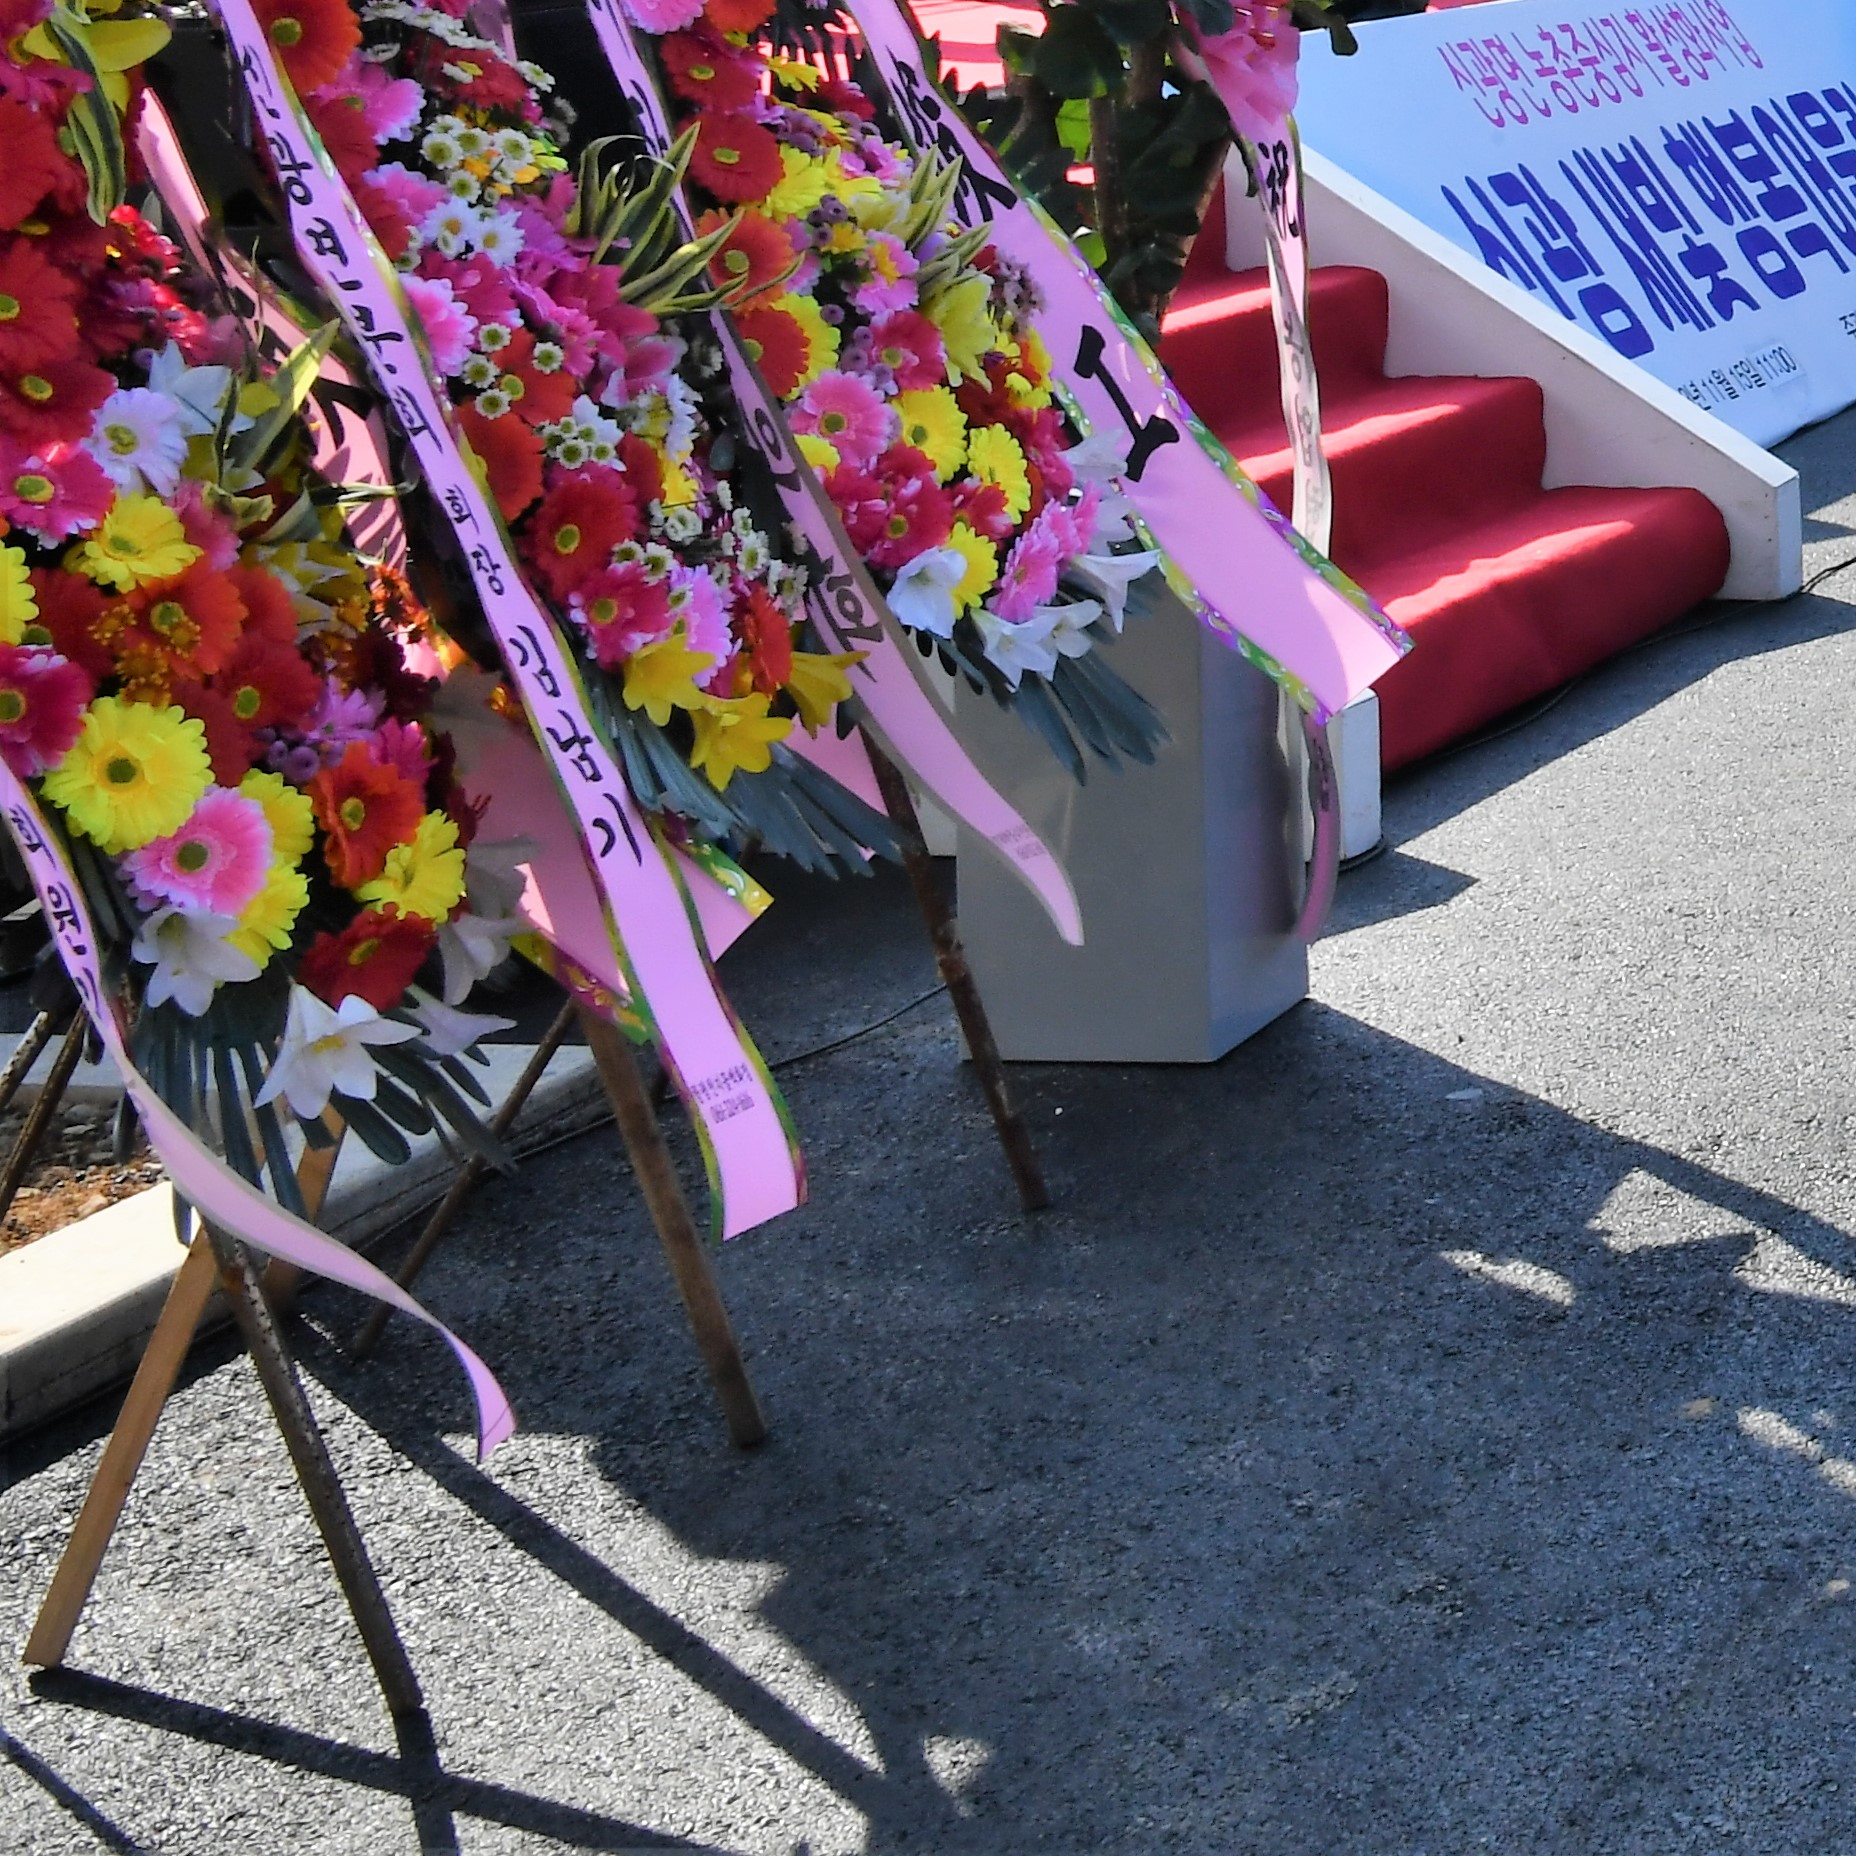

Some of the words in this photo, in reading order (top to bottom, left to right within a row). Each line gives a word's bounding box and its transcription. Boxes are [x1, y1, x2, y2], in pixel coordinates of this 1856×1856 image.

[1437, 33, 1551, 129] 신광면
[1511, 12, 1664, 114] 농촌중심지
[1441, 162, 1655, 359] 신광
[1558, 134, 1761, 333] 새빛
[510, 625, 642, 866] 김남기
